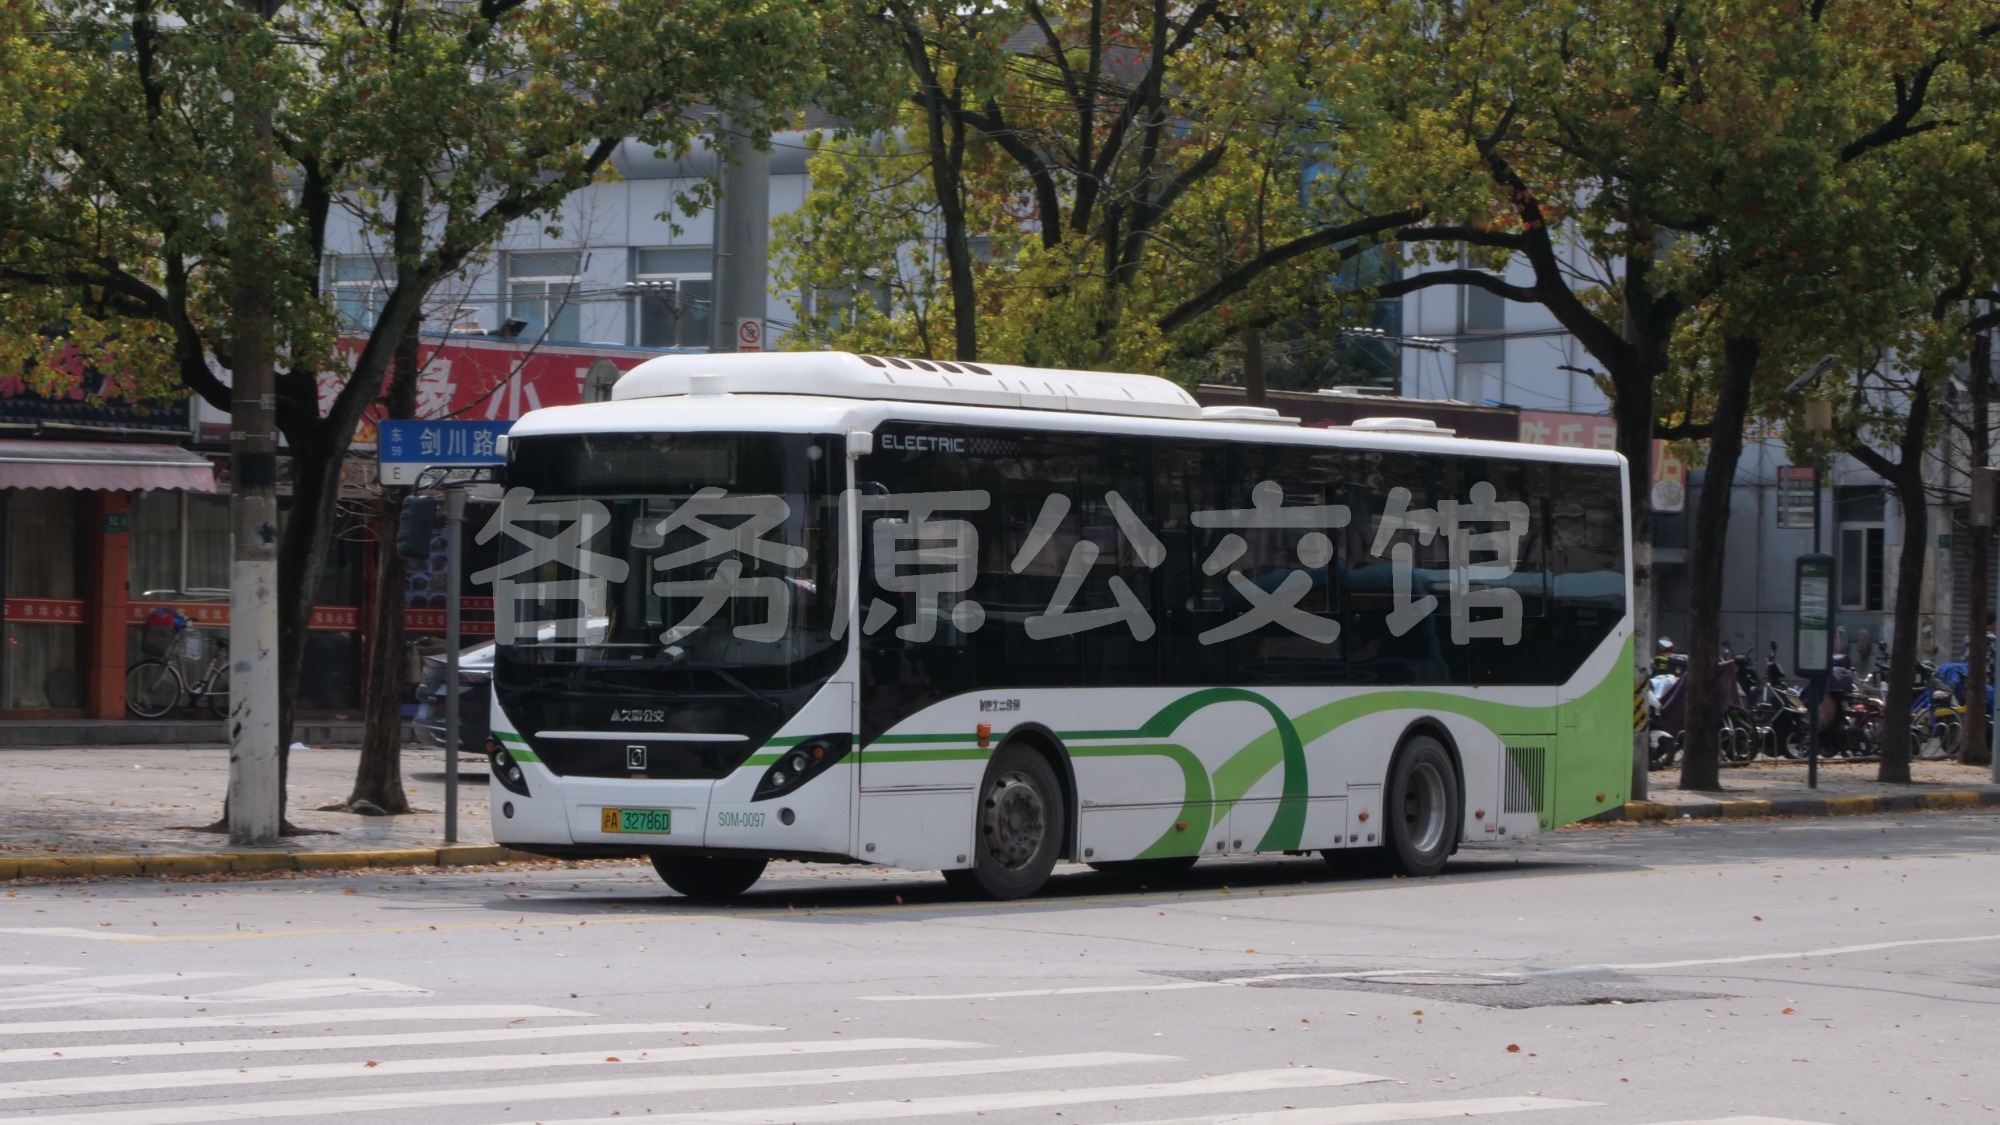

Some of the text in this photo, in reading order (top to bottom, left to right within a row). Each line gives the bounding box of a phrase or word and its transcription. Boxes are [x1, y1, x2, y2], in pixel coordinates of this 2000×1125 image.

[420, 428, 495, 457] 剑川路
[881, 434, 965, 453] ELECTRIC
[393, 467, 401, 480] E
[623, 812, 669, 831] 32786D
